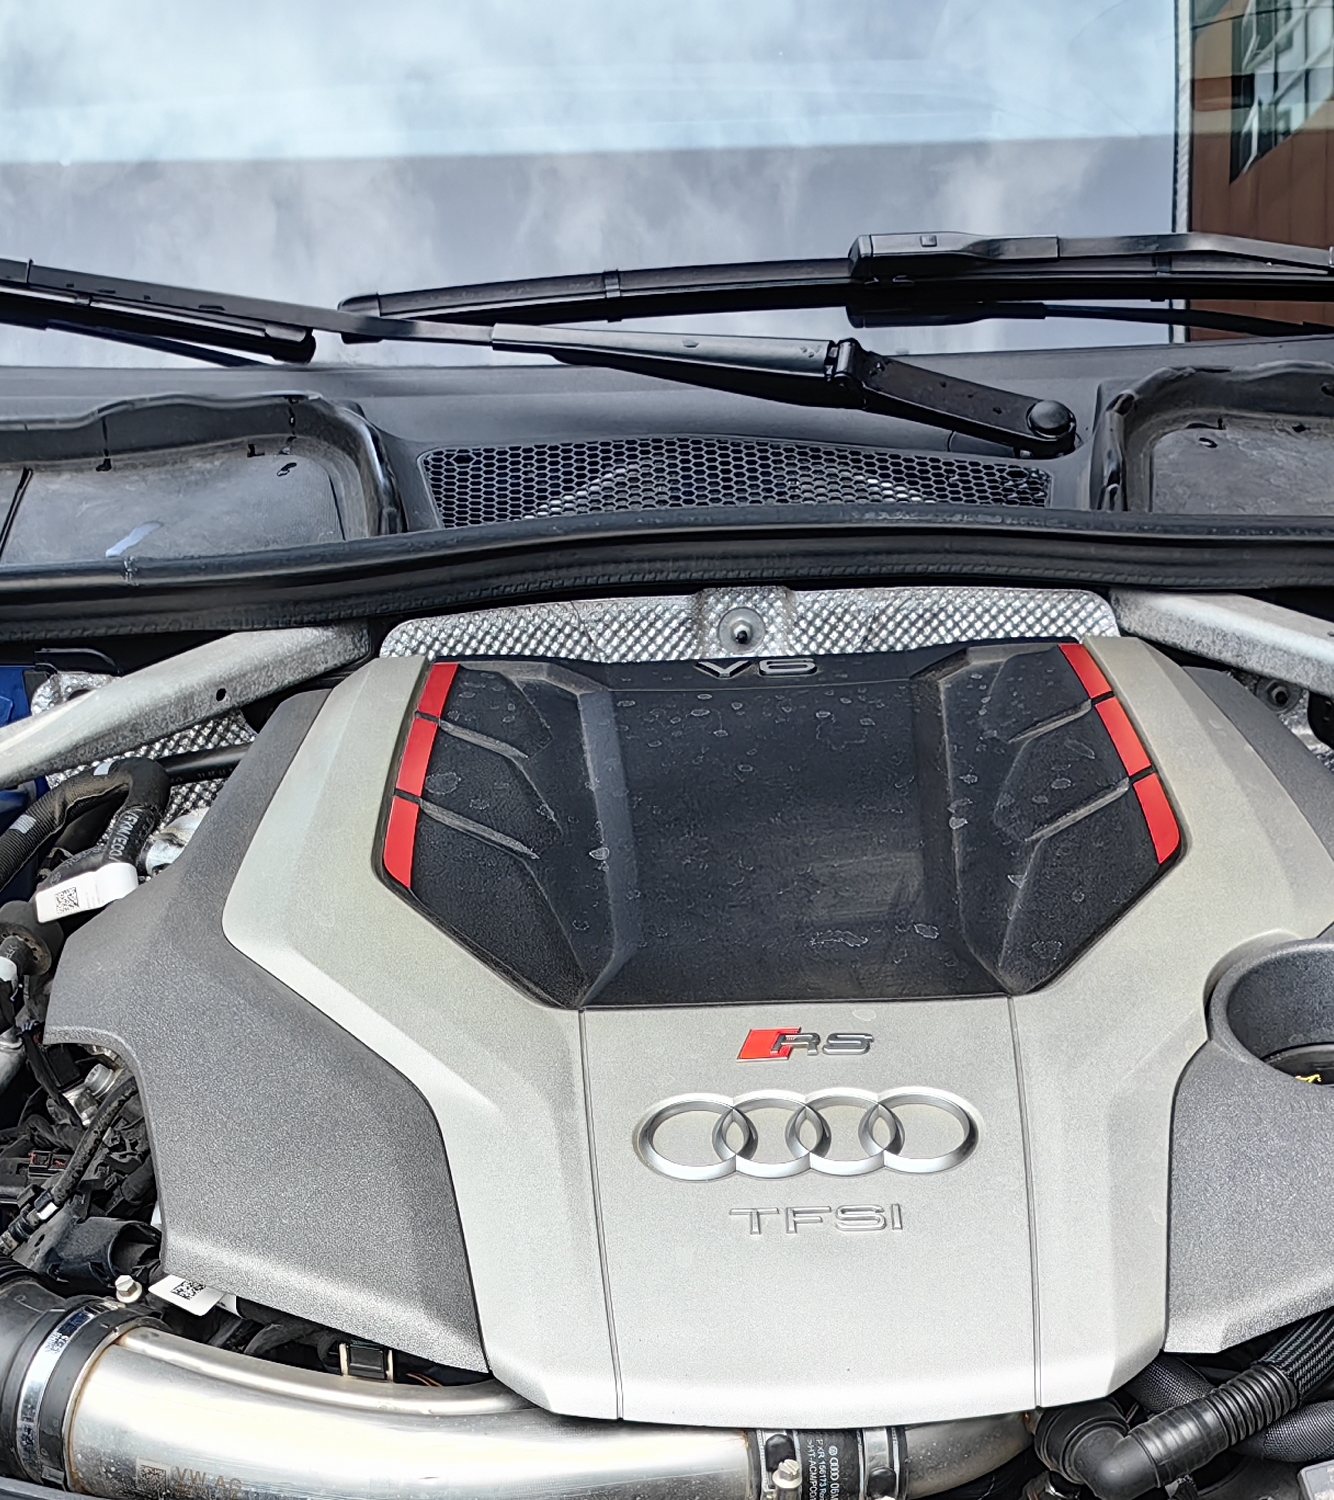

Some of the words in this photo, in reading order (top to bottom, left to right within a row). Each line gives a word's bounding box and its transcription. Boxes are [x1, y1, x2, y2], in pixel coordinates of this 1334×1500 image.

[694, 658, 817, 680] V6
[769, 1031, 875, 1056] RS
[729, 1203, 903, 1236] TFSI
